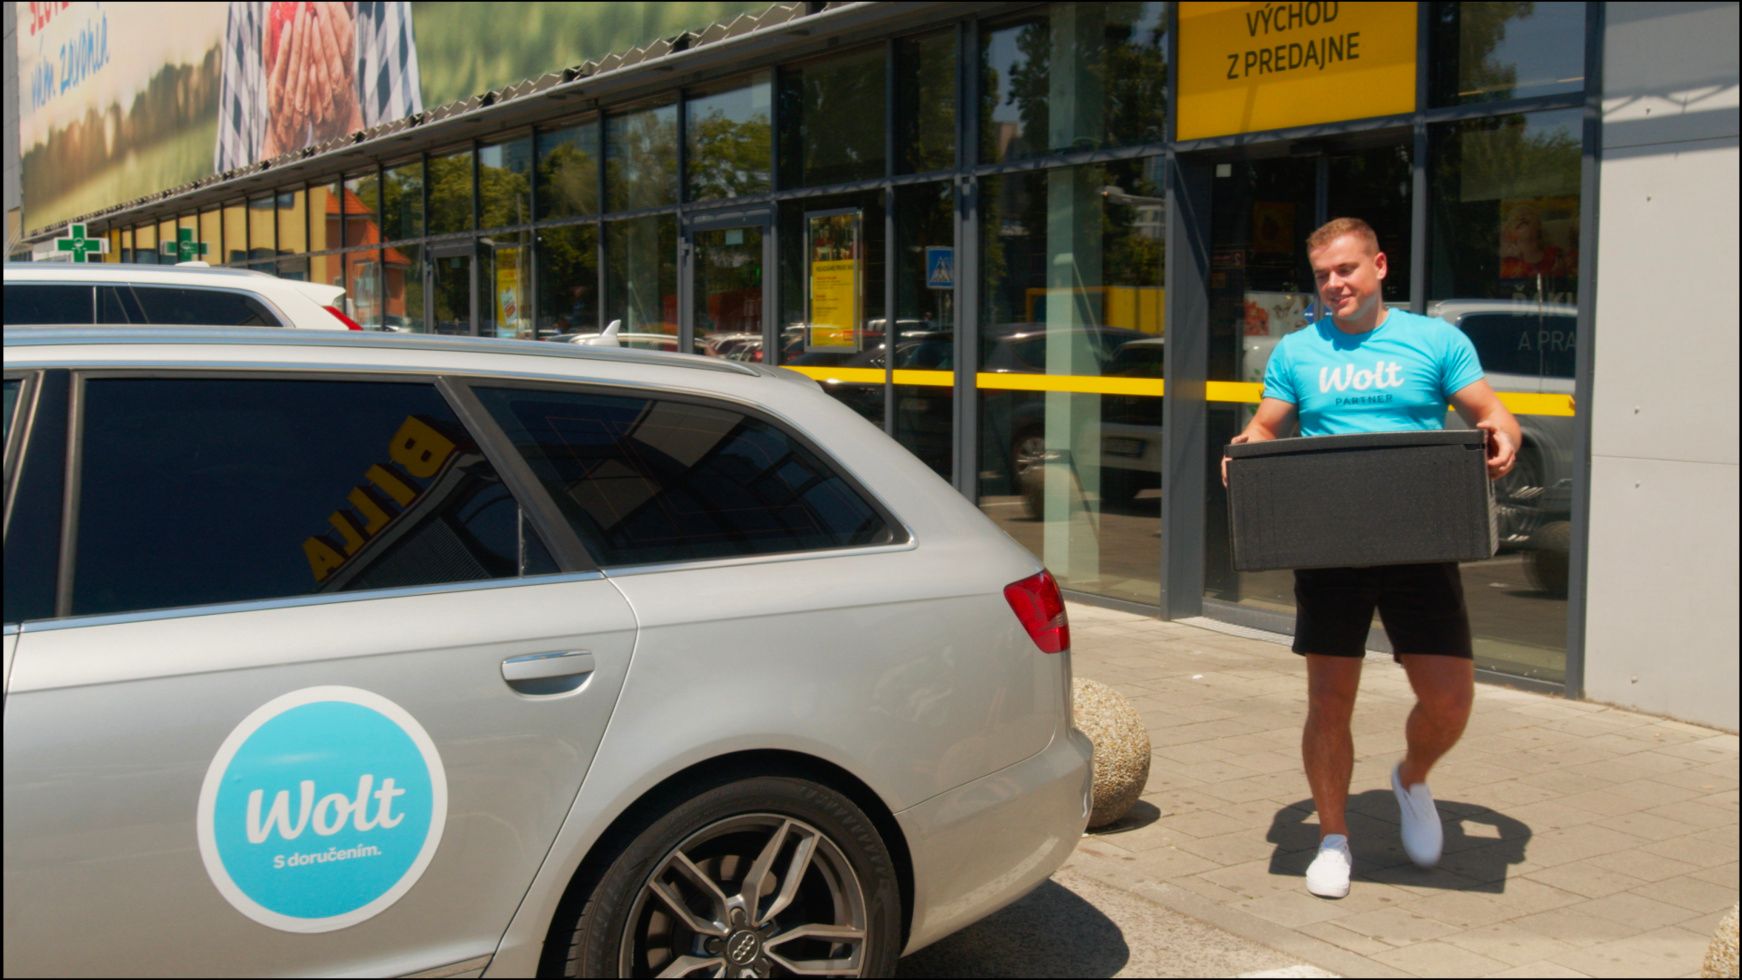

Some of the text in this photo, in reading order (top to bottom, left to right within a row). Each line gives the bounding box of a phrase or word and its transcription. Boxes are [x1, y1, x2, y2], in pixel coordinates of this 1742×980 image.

[1246, 2, 1338, 37] VÝCHOD
[1227, 32, 1360, 79] Z PREDAJNE
[1318, 361, 1405, 394] Wolt
[1335, 394, 1393, 406] PARTNER
[246, 773, 406, 844] Wolt
[273, 844, 382, 869] S doručením.
